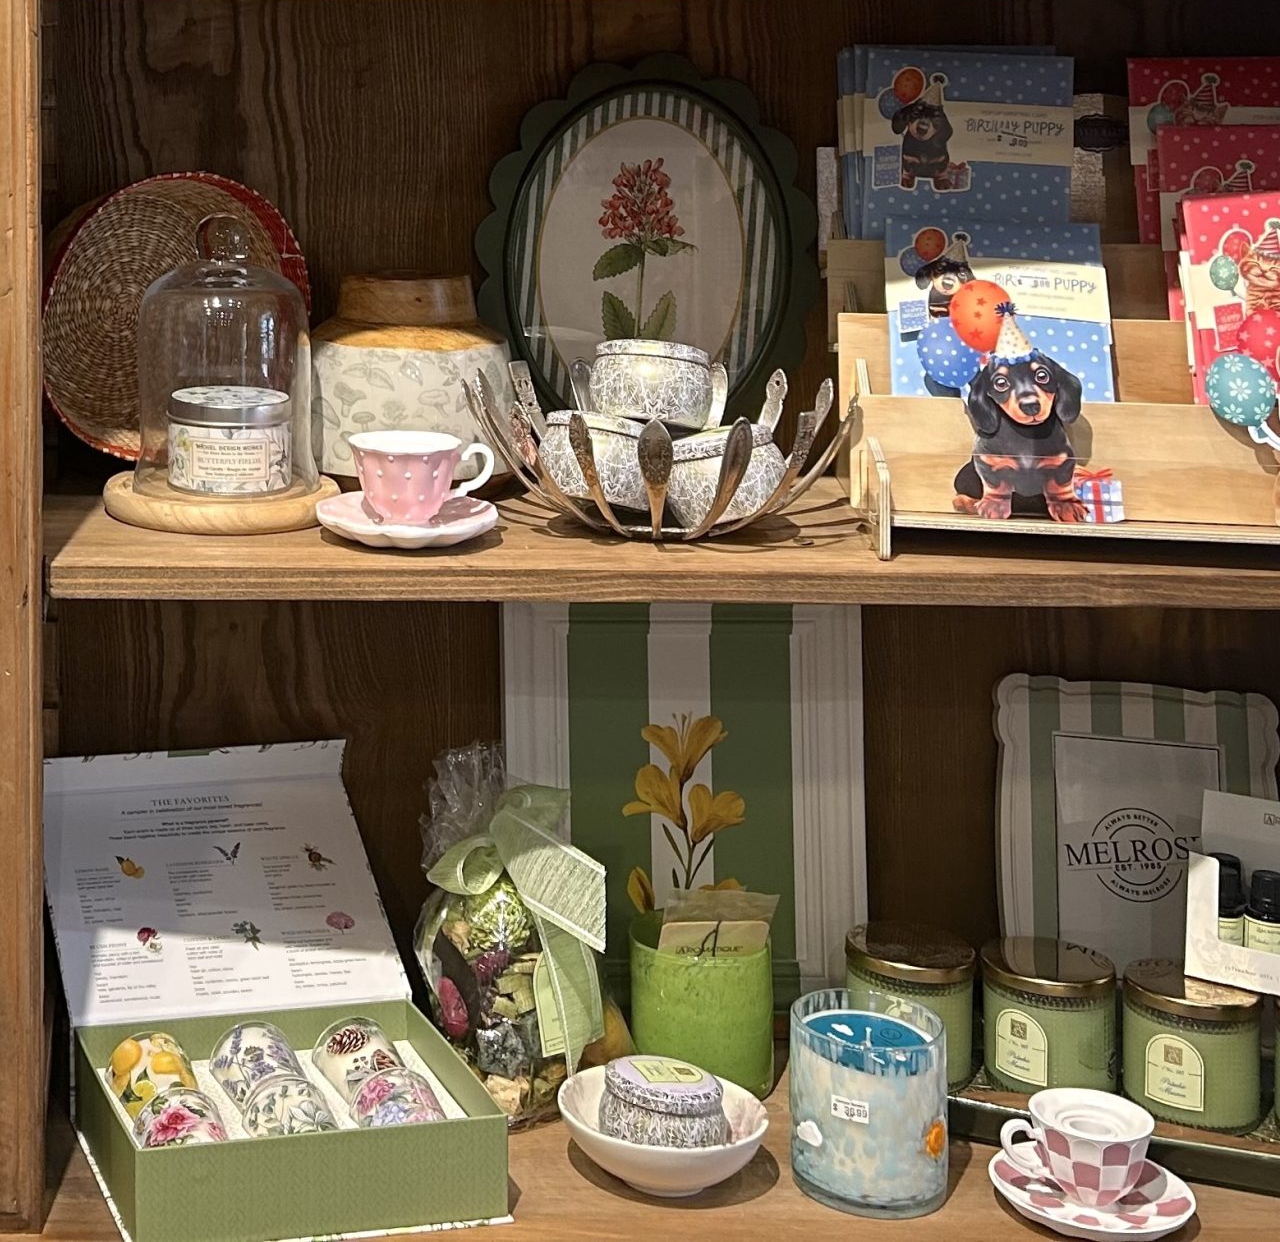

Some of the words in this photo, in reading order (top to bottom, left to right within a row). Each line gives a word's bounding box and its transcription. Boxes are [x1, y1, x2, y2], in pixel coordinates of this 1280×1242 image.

[1023, 120, 1064, 136] PUPPY
[1054, 277, 1097, 294] PUPPY
[150, 798, 172, 807] THE
[174, 795, 230, 806] FAVORITES
[1104, 814, 1132, 831] ALWAYS
[1133, 813, 1160, 828] BETTER
[1065, 836, 1202, 867] MELROS
[1115, 862, 1137, 872] EST.
[1140, 861, 1162, 871] 1985
[1110, 879, 1141, 896] ALWAYS
